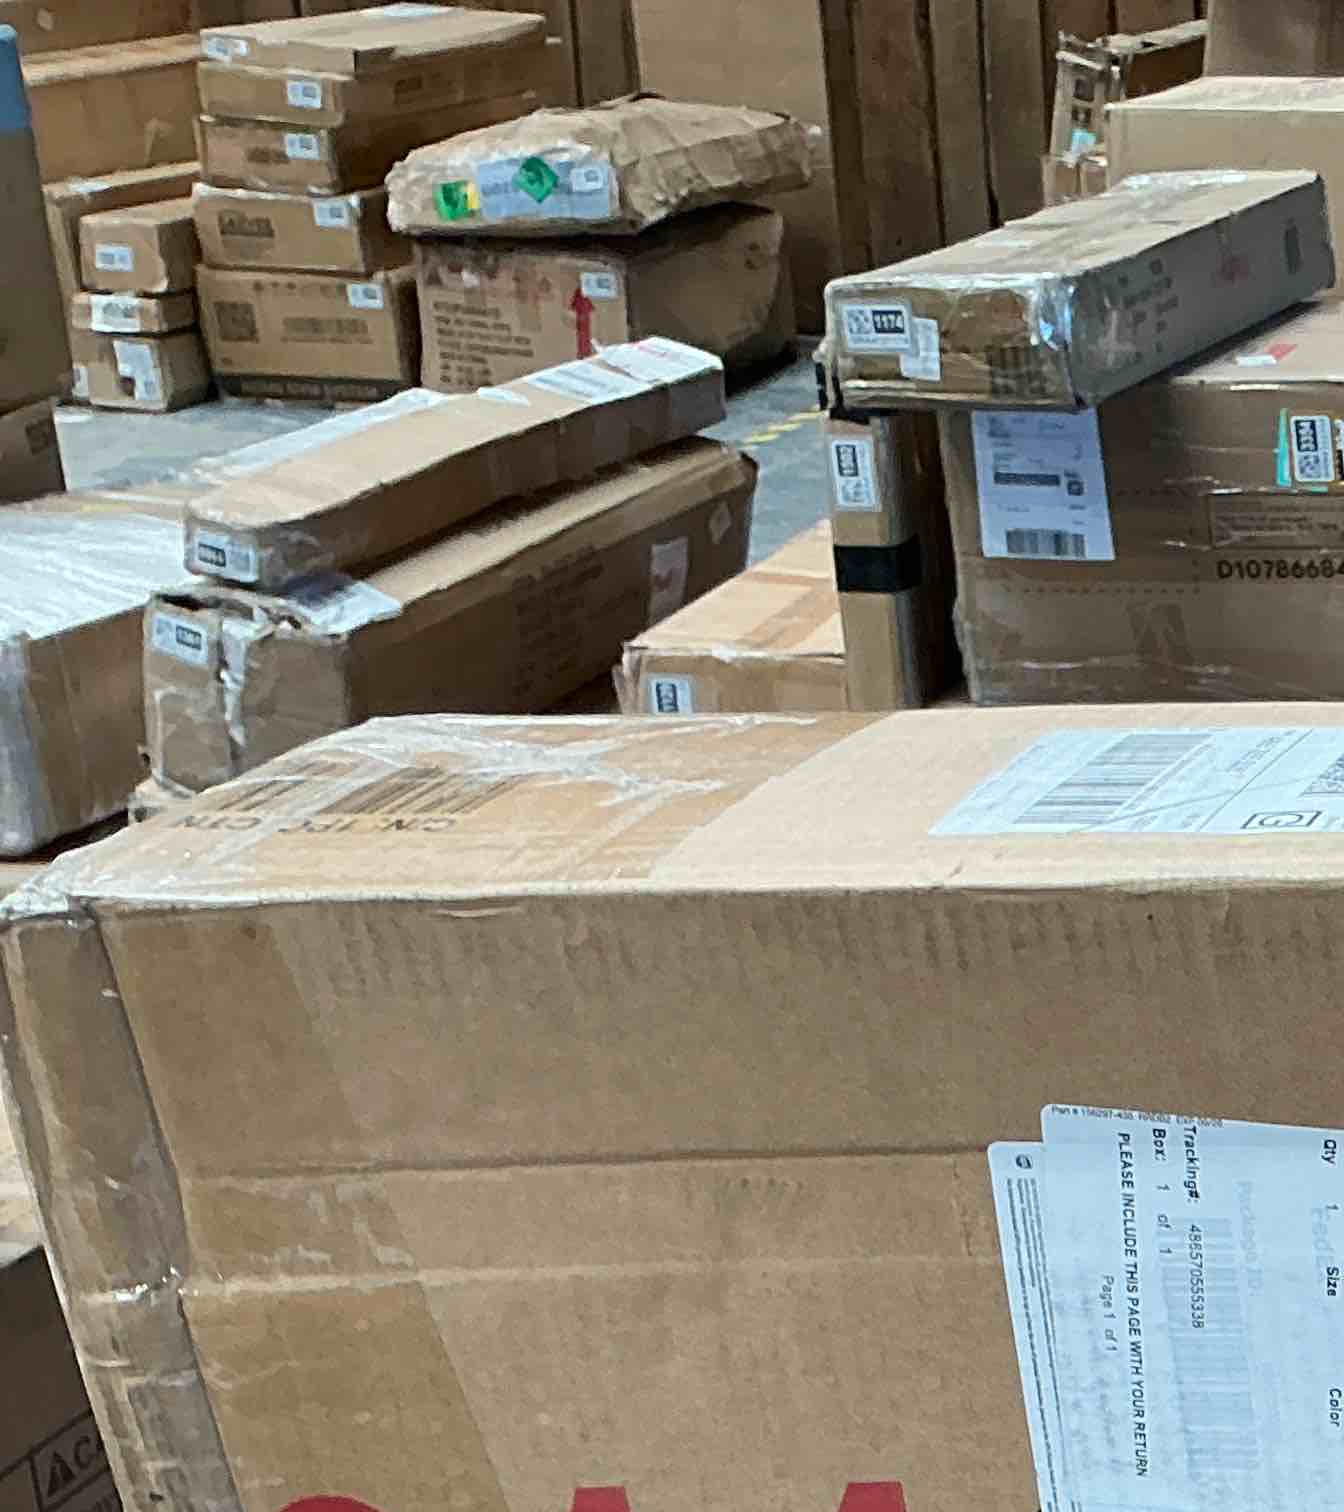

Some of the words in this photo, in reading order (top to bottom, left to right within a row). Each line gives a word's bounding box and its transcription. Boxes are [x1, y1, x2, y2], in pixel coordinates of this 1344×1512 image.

[1118, 1132, 1134, 1189] PLEASE
[1152, 1128, 1166, 1161] Box:
[1321, 1139, 1336, 1165] Qty
[1184, 1126, 1200, 1203] Tracking#:
[1121, 1193, 1137, 1258] INCLUDE
[1099, 1274, 1114, 1308] Page
[1125, 1262, 1138, 1293] THIS
[1326, 1266, 1340, 1296] Size
[1127, 1297, 1141, 1336] PAGE
[1130, 1341, 1144, 1376] WITH
[1131, 1380, 1144, 1418] YOUR
[1329, 1388, 1343, 1427] Color
[1134, 1421, 1148, 1477] RETURN
